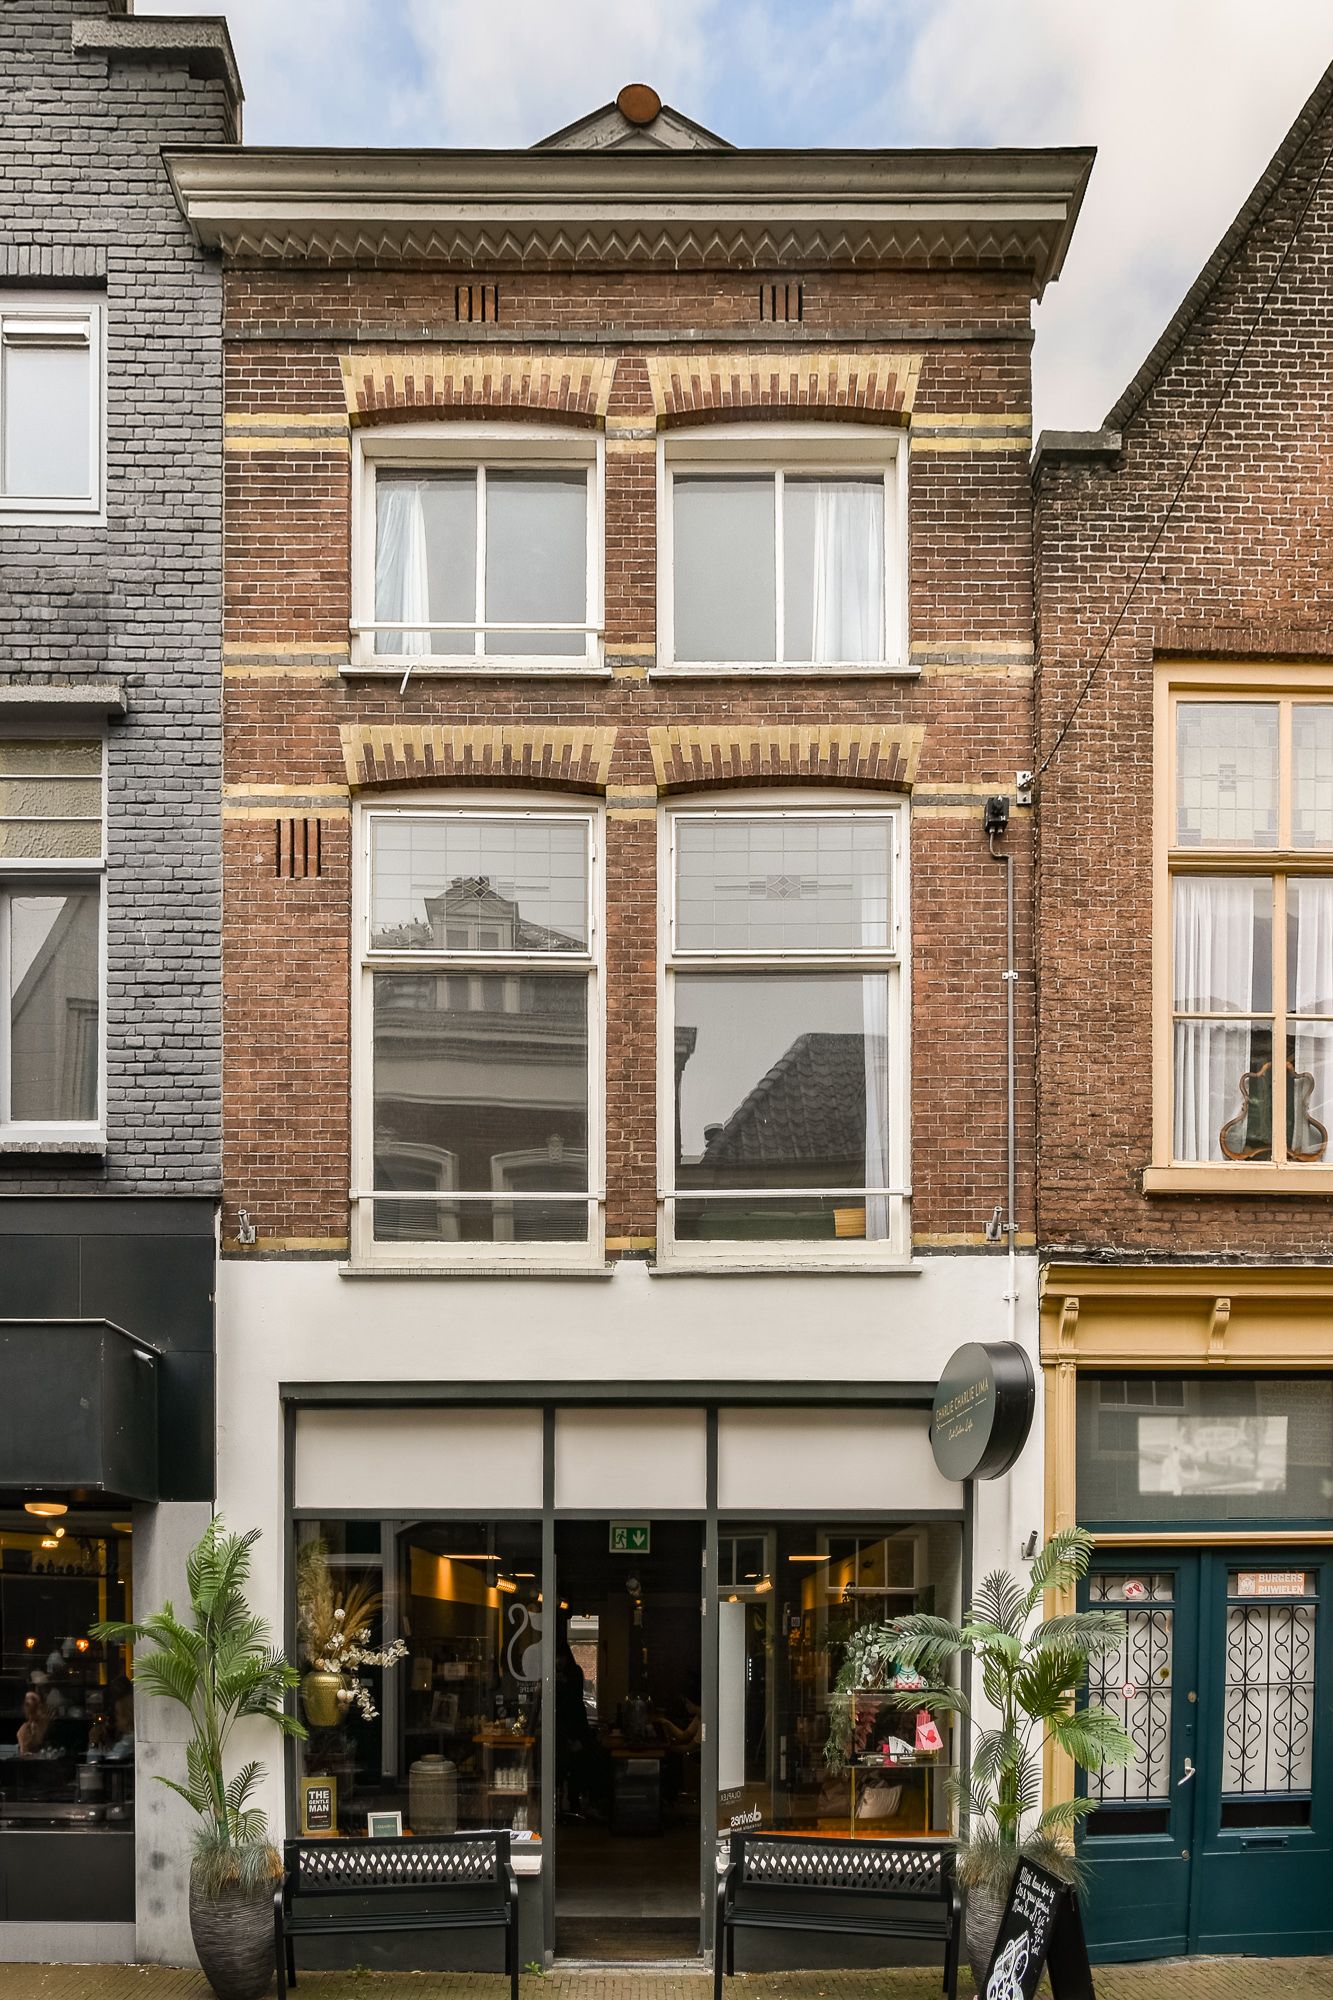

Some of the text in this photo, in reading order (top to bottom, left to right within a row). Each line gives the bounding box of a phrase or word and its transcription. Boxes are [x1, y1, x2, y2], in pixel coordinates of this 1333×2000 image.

[935, 1377, 989, 1422] CHARLIE CHARLIE LIMA
[1259, 1574, 1303, 1583] BURGERS
[309, 1790, 329, 1800] THE
[309, 1804, 329, 1812] MAN
